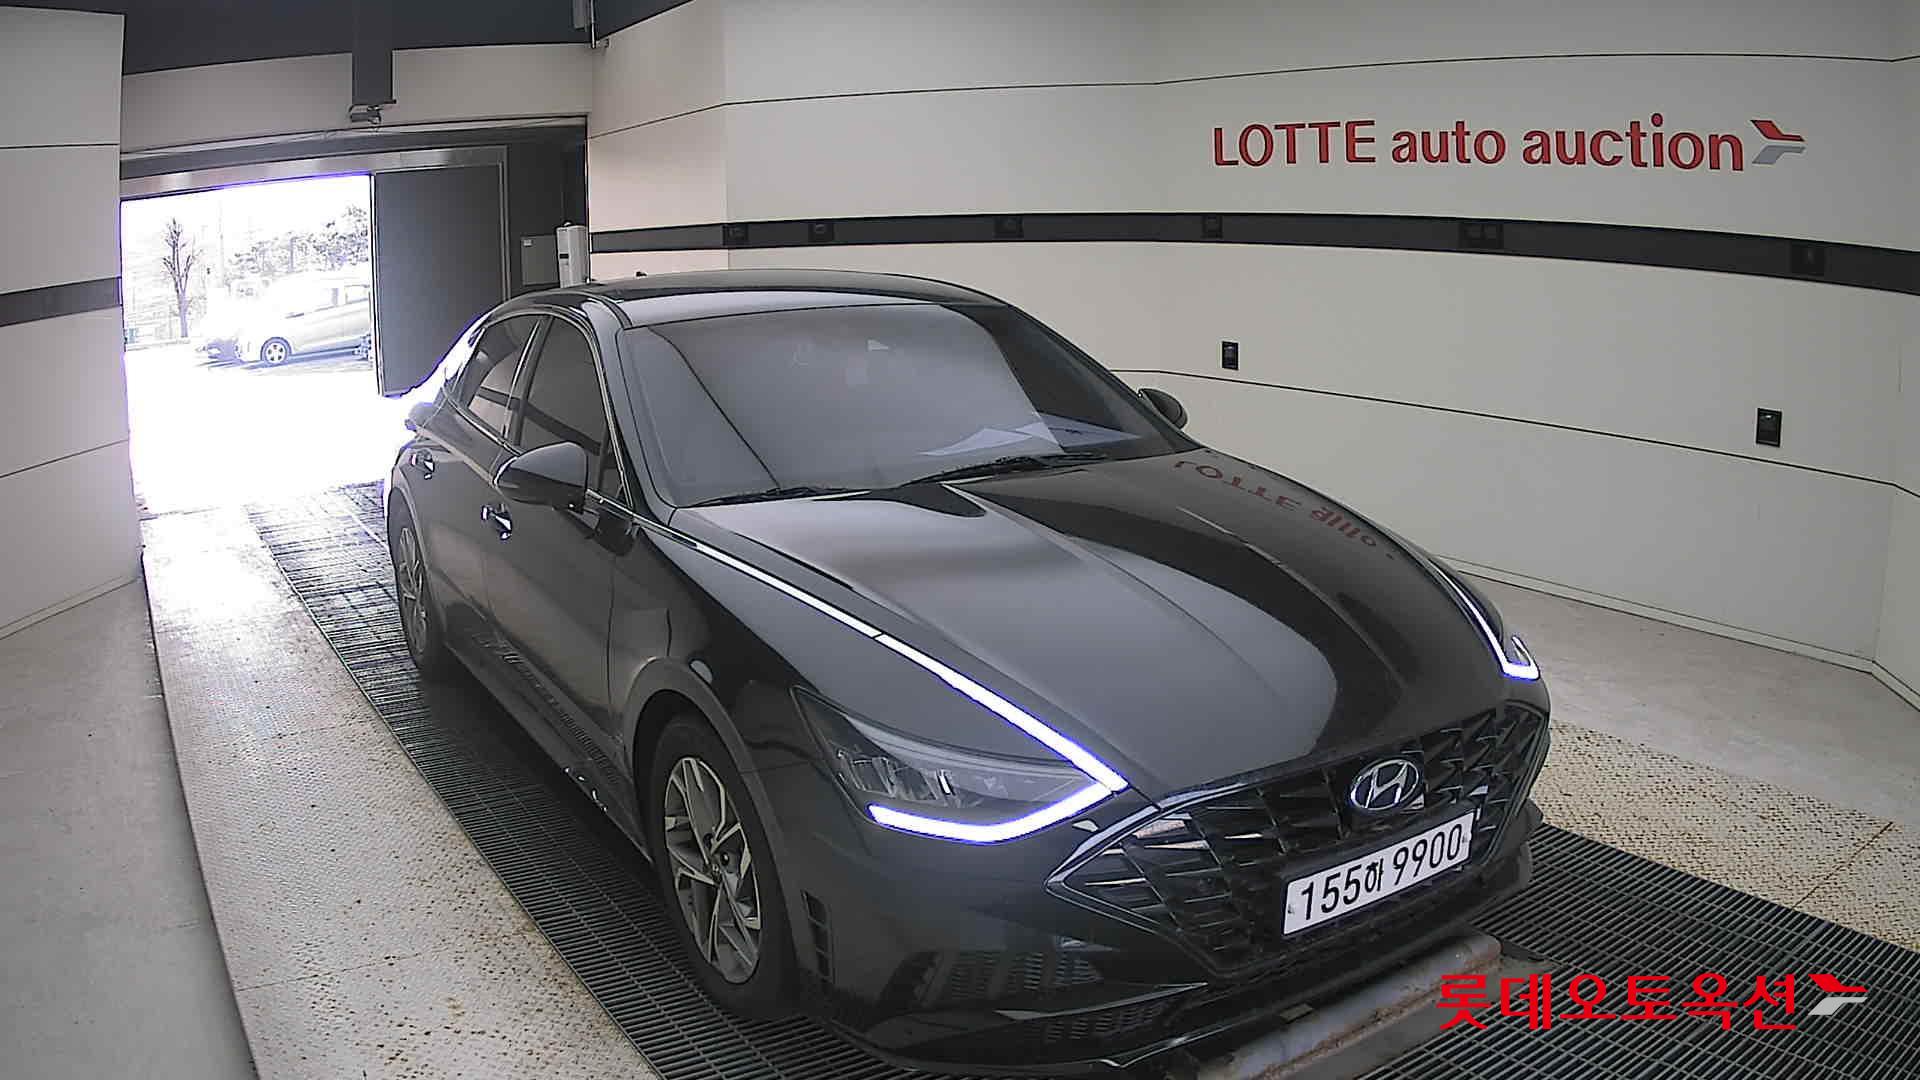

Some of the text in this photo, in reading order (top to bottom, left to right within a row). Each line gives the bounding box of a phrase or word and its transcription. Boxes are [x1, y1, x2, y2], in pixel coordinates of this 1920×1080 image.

[1214, 113, 1745, 171] LOTTE auto auction
[1301, 824, 1463, 920] 155하 9900
